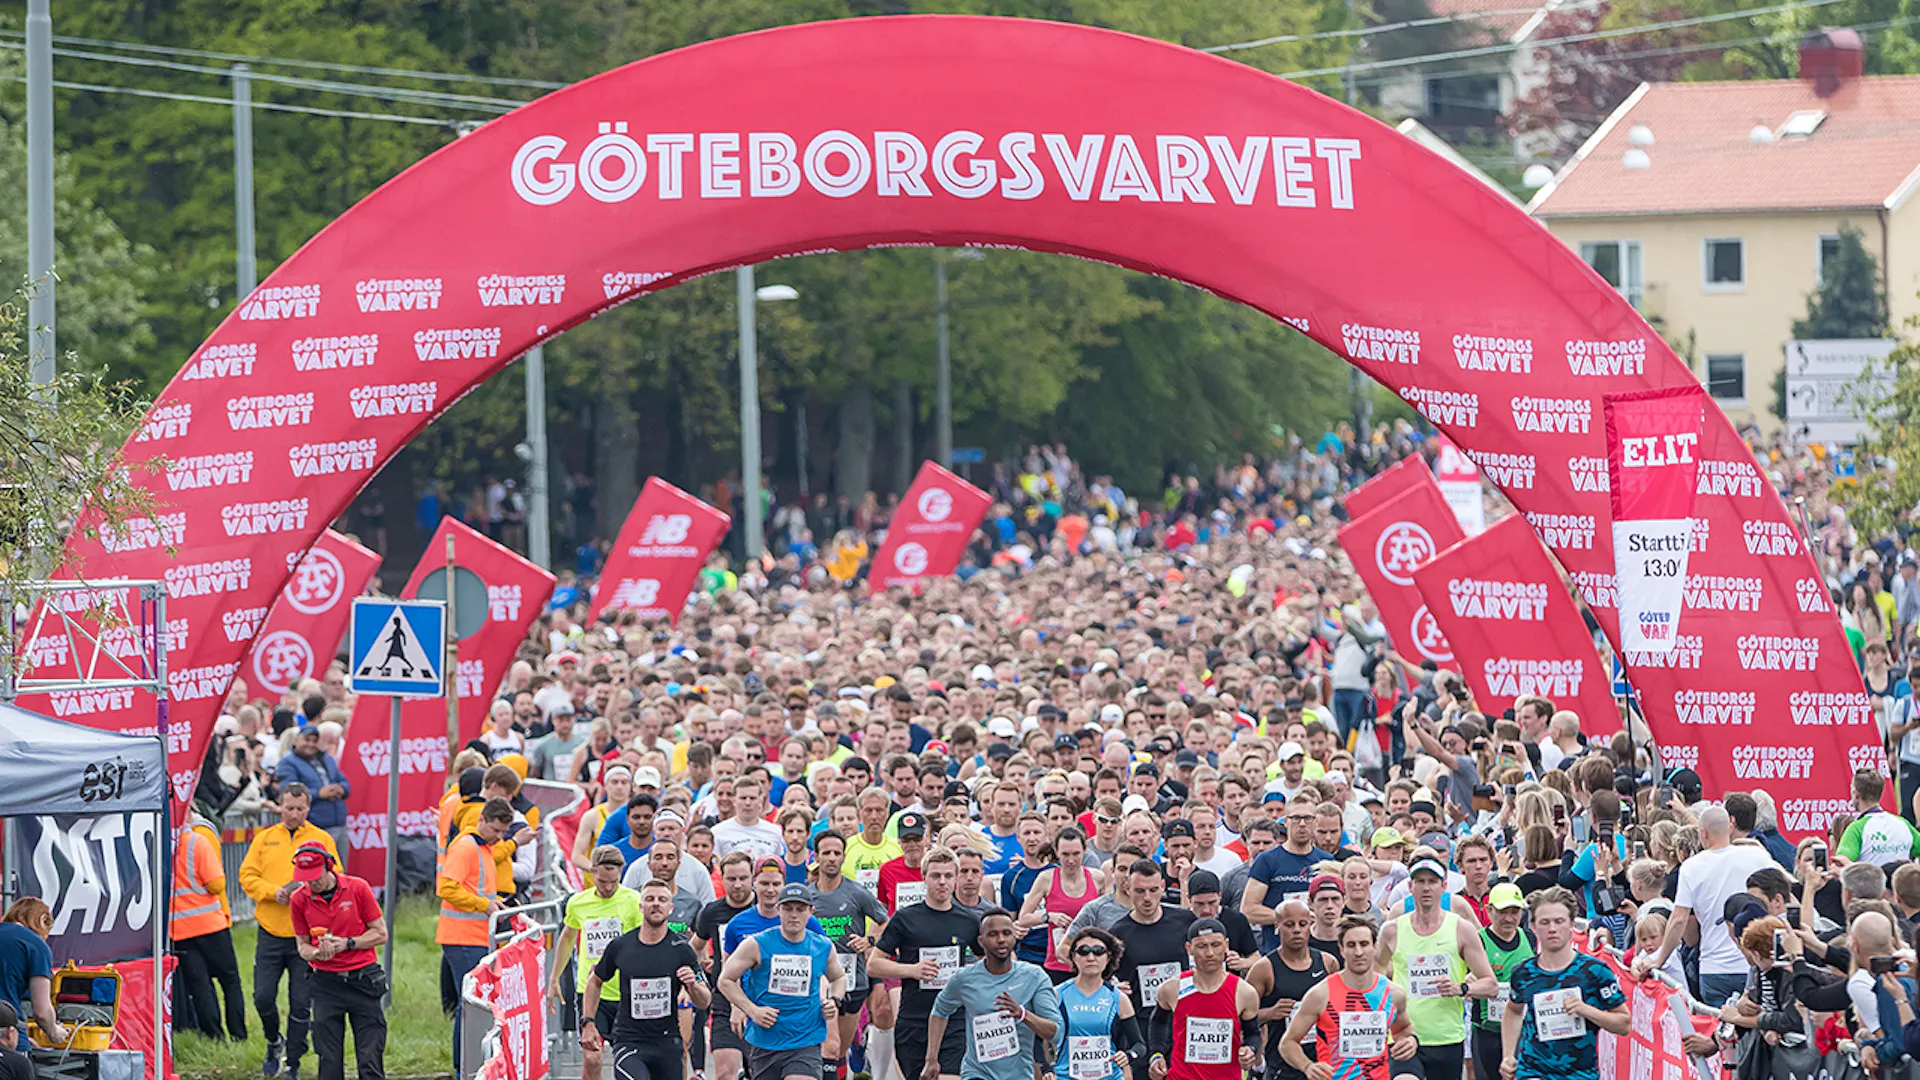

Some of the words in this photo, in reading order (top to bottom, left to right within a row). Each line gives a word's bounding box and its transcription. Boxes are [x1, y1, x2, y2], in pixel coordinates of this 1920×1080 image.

[511, 122, 1361, 209] GÖTEBORGSVARVET
[253, 284, 321, 301] TEBORGS
[355, 278, 442, 295] GÖTEBORGS
[477, 274, 566, 290] GÖTEBORGS
[356, 291, 442, 313] VARVET
[478, 286, 566, 307] VARVET
[291, 334, 379, 353] GÖTEBORGS
[413, 327, 501, 344] GÖTEBORGS
[1341, 323, 1420, 345] GÖTEBORGS
[1452, 334, 1533, 353] GÖTEBORGS
[201, 343, 257, 359] EBORGS
[414, 339, 500, 361] VARVET
[1342, 337, 1420, 365] VARVET
[1565, 338, 1646, 354] GÖTEBORGS
[182, 356, 256, 381] ARVET
[292, 347, 378, 372] VARVET
[1454, 348, 1533, 374] VARVET
[1566, 353, 1645, 376] VARVET
[227, 392, 314, 412] GÖTEBORGS
[350, 381, 437, 402] GÖTEBORGS
[1400, 386, 1478, 408] GÖTEBORGS
[350, 395, 436, 419] VARVET
[1416, 402, 1478, 428] ARVET
[1511, 396, 1591, 414] GÖTEBORGS
[227, 405, 314, 431] VARVET
[1512, 410, 1591, 434] VARVET
[289, 438, 377, 460] GÖTEBORGS
[1622, 432, 1698, 467] ELIT
[289, 452, 377, 477] VARVET
[167, 465, 253, 491] VARVET
[1484, 464, 1536, 489] RVET
[1569, 470, 1611, 492] VAR
[1697, 473, 1763, 497] ARVET
[221, 498, 309, 519] GÖTEBORGS
[222, 511, 308, 536] VARVET
[1521, 511, 1595, 530] ÖTEBORGS
[1742, 520, 1792, 537] GÖTEB
[1537, 526, 1595, 550] RVET
[1628, 534, 1685, 552] Startti
[1744, 534, 1799, 556] VARV
[164, 558, 251, 582] GÖTEBORGS
[1643, 559, 1681, 577] 13:0
[165, 571, 251, 599] VARVET
[1448, 579, 1548, 598] GÖTEBORGS
[1683, 576, 1763, 592] GÖTEBORGS
[1449, 594, 1547, 620] VARVET
[1684, 590, 1762, 612] VARVET
[1736, 635, 1820, 651] GÖTEBORGS
[1484, 657, 1583, 676] GÖTEBORGS
[1737, 649, 1819, 671] VARVET
[169, 661, 240, 683] GÖTEBOR
[169, 676, 233, 702] VARV
[1484, 671, 1583, 697] VARVET
[50, 689, 134, 716] VARVET
[1674, 690, 1756, 706] GÖTEBORGS
[1674, 704, 1755, 725] VARVET
[1790, 705, 1871, 725] VARVET
[1732, 746, 1815, 761] GÖTEBORGS
[1733, 759, 1815, 779] VARVET
[1783, 799, 1856, 814] GÖTEBORG
[587, 931, 620, 940] DAVID
[773, 968, 809, 977] JOHAN
[1410, 968, 1449, 977] MARTIN
[976, 1025, 1014, 1040] MAHED
[1190, 1033, 1229, 1043] LARIF
[1342, 1027, 1385, 1036] DANIEL
[1072, 1050, 1109, 1061] AKIKO
